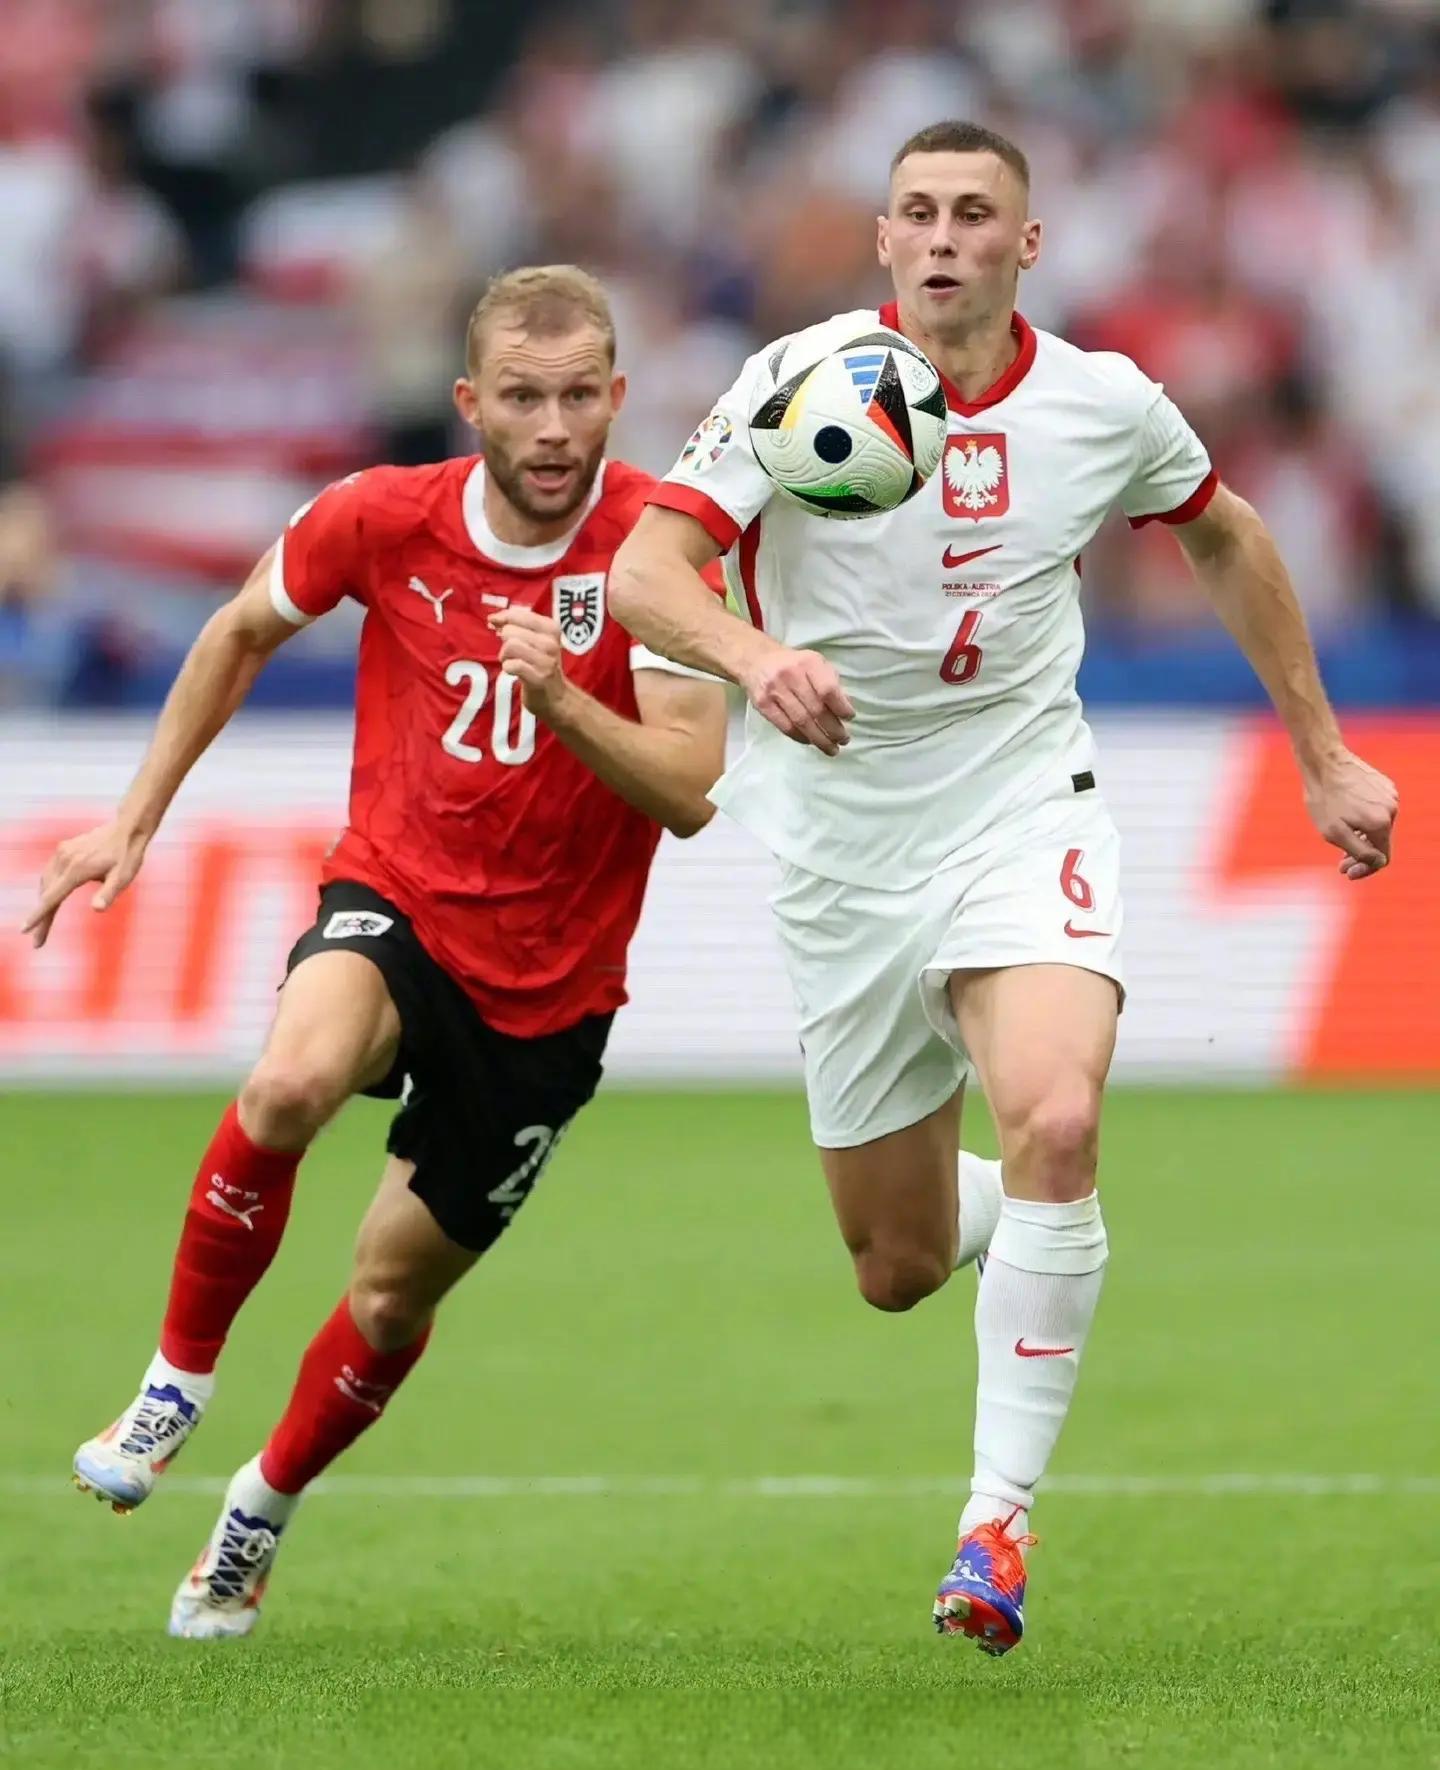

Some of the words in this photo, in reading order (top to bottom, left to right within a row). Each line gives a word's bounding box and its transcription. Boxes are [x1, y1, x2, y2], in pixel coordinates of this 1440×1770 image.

[939, 609, 983, 685] 6
[441, 660, 535, 765] 20
[1060, 849, 1096, 912] 6
[487, 1125, 560, 1202] 2
